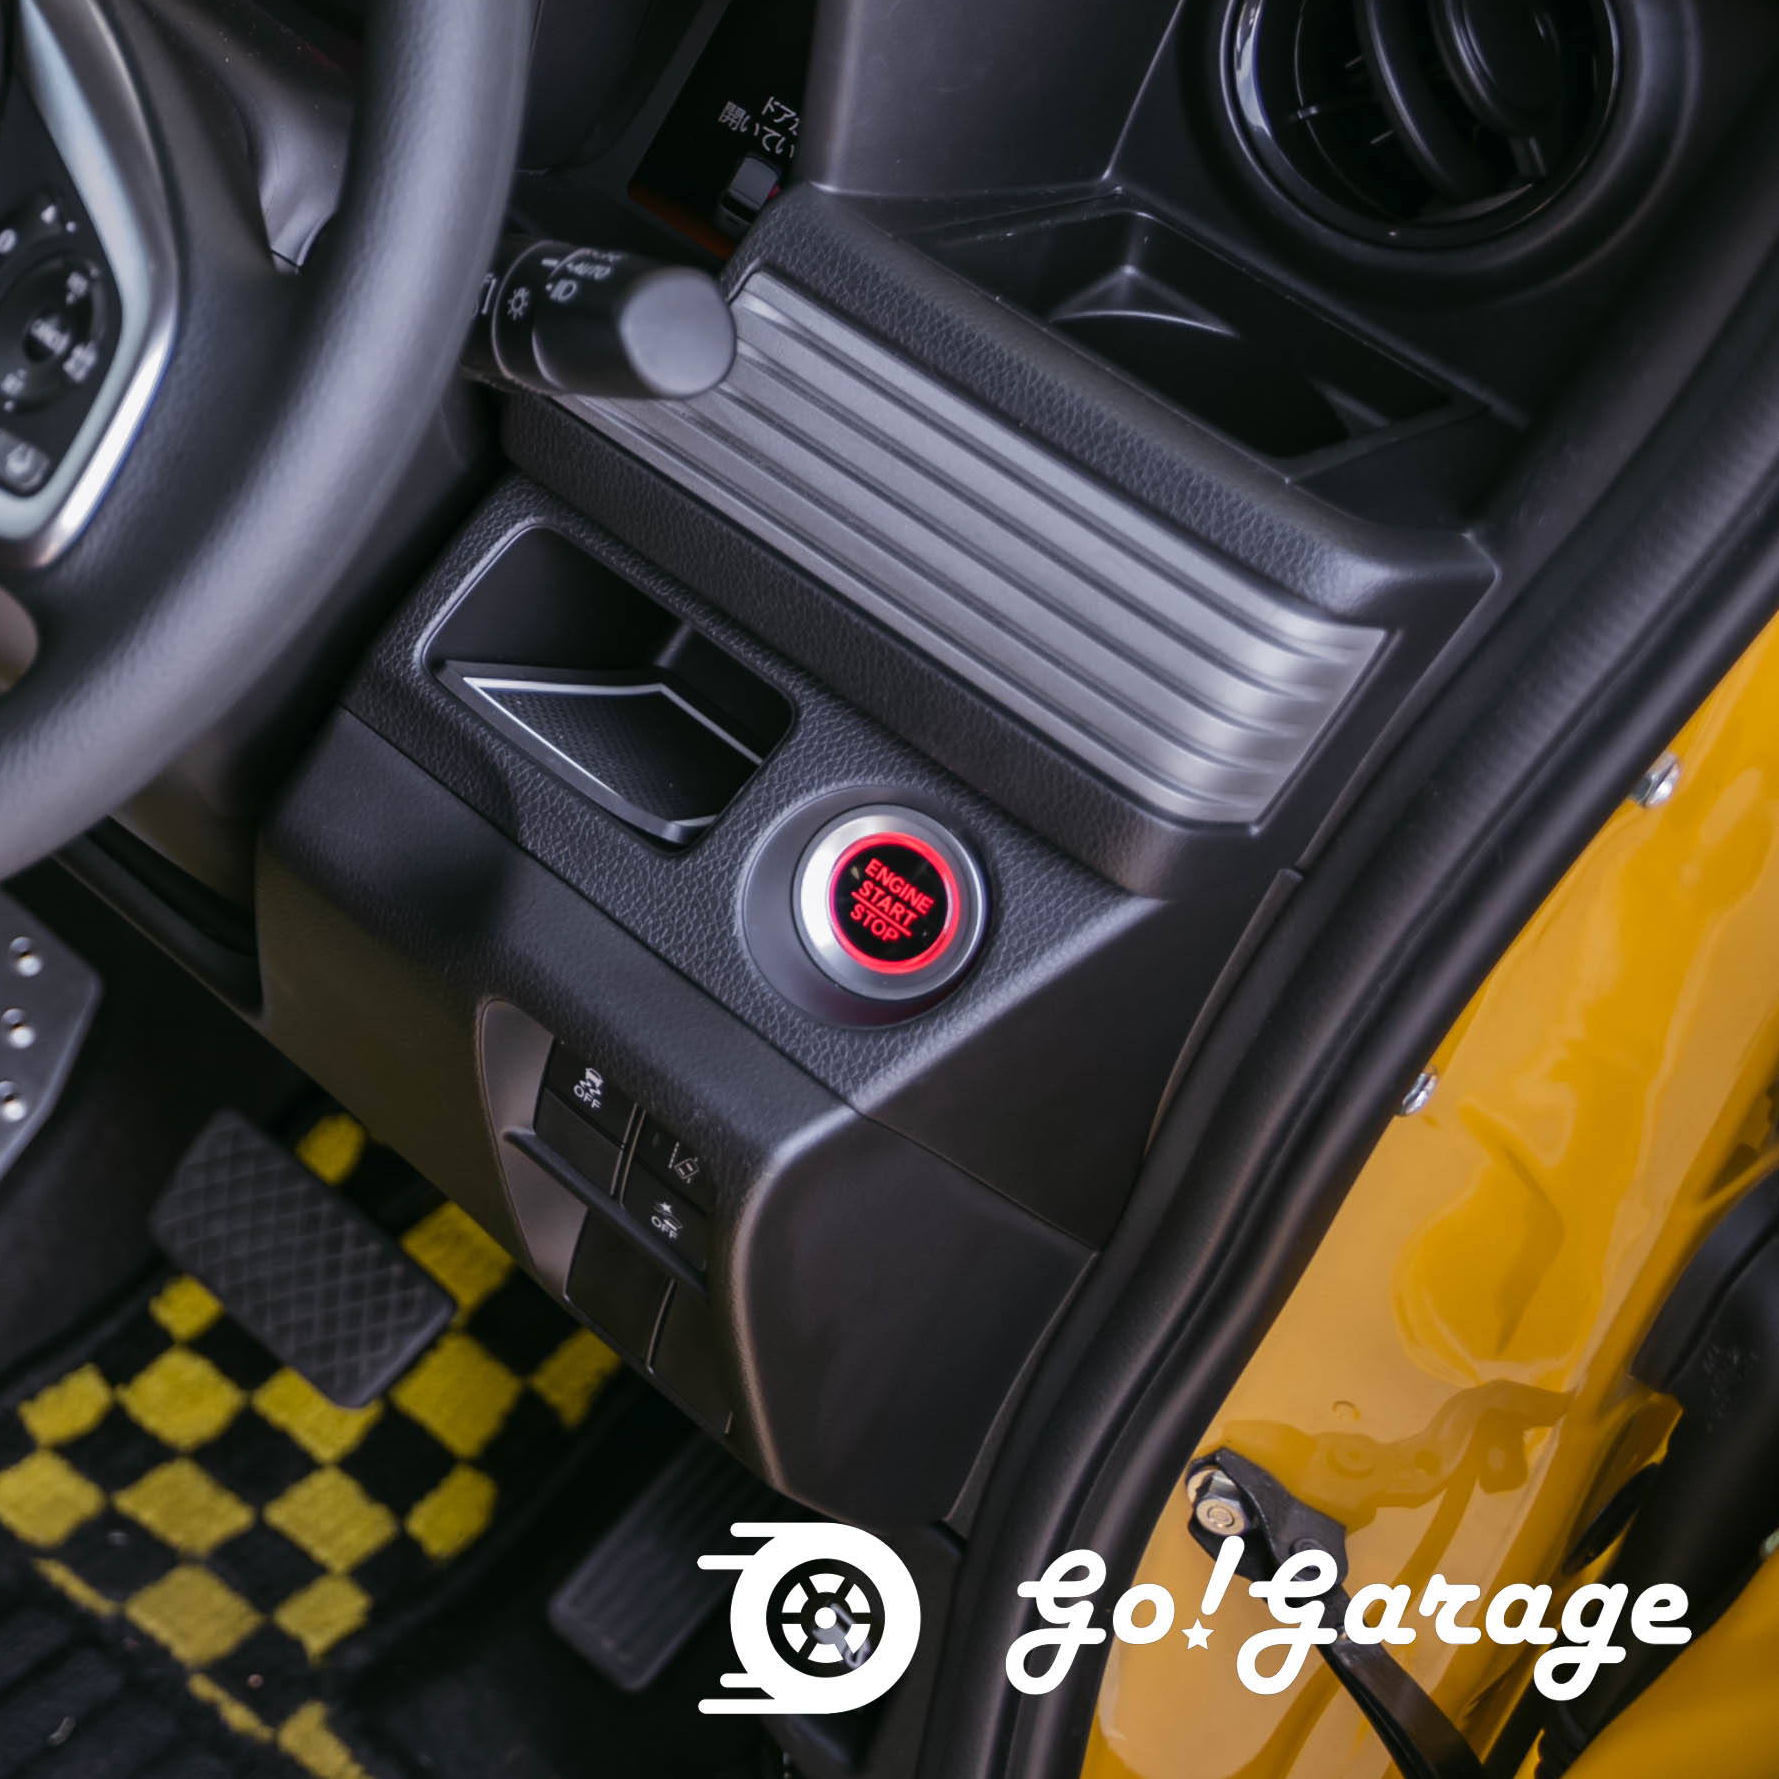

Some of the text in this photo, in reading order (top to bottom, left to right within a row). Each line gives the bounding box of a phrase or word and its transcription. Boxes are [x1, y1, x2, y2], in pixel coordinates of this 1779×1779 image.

[858, 880, 919, 926] START
[865, 858, 935, 915] ENGINE
[850, 903, 899, 941] STOP
[573, 1085, 601, 1109] OFF
[651, 1215, 678, 1240] OFF
